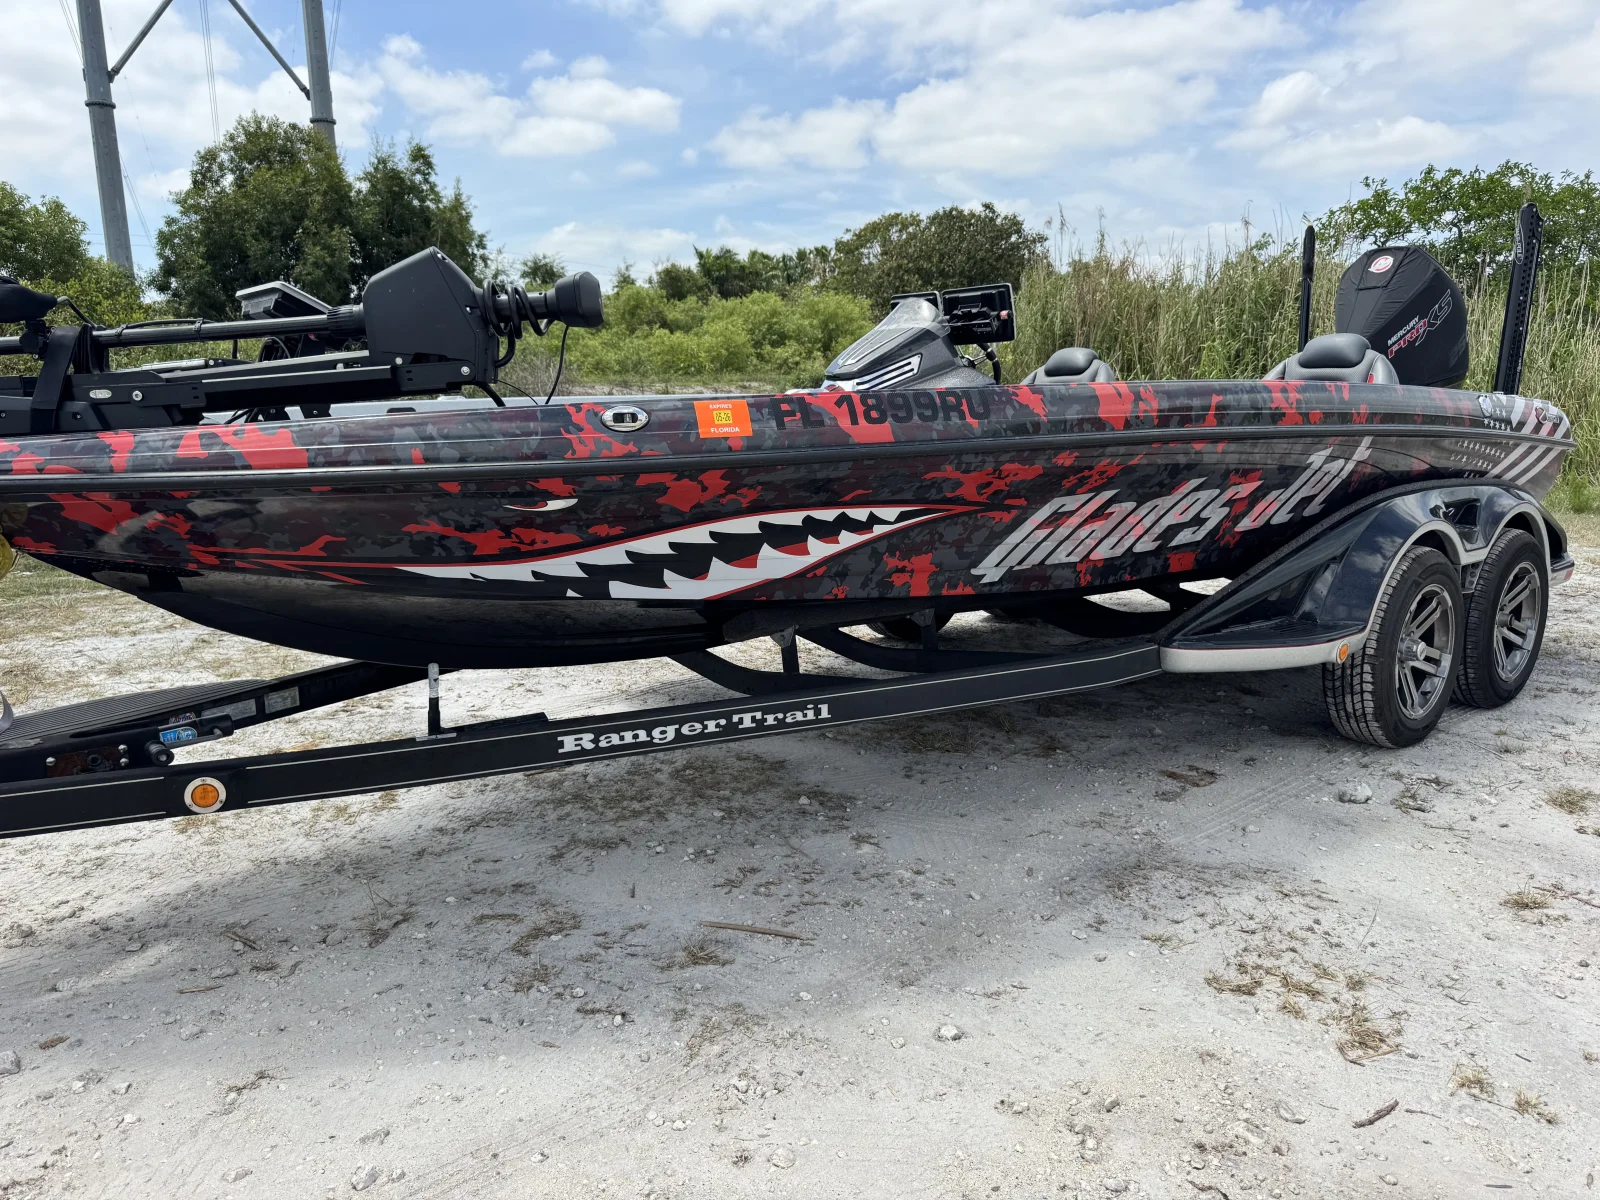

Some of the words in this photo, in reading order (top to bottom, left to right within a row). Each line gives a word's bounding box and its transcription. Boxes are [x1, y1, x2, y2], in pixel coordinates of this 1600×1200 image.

[1388, 315, 1420, 347] MERCURY
[710, 426, 740, 434] FLORIDA
[769, 396, 826, 431] FL
[970, 477, 1263, 583] Glades
[557, 718, 727, 753] Ranger
[732, 704, 832, 729] Trail
